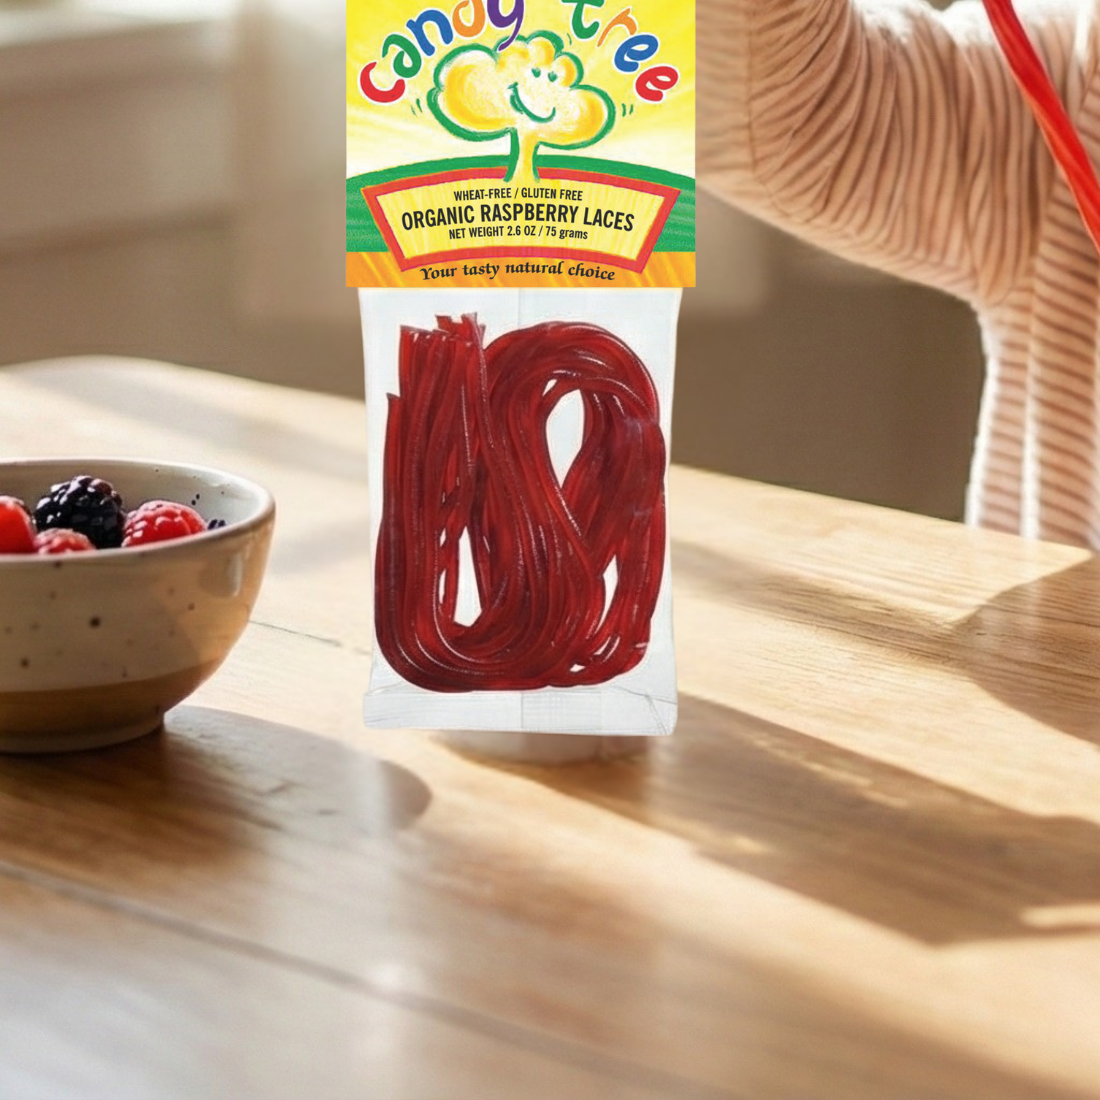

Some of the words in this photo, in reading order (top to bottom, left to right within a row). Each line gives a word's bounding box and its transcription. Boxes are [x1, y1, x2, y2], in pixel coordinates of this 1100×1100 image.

[454, 188, 511, 201] WHEAT-FREE
[521, 188, 556, 199] GLUTEN
[560, 190, 583, 201] FREE
[402, 206, 475, 230] ORGANIC
[481, 203, 578, 223] RASPBERRY
[583, 208, 635, 231] LACES
[449, 228, 466, 239] NET
[469, 226, 504, 238] WEIGHT
[507, 225, 521, 236] 2.6
[524, 225, 536, 236] OZ
[546, 226, 556, 236] 75
[559, 228, 588, 239] grams
[420, 266, 457, 280] Your
[463, 263, 500, 279] tasty
[506, 261, 564, 274] natural
[568, 262, 615, 280] choice
